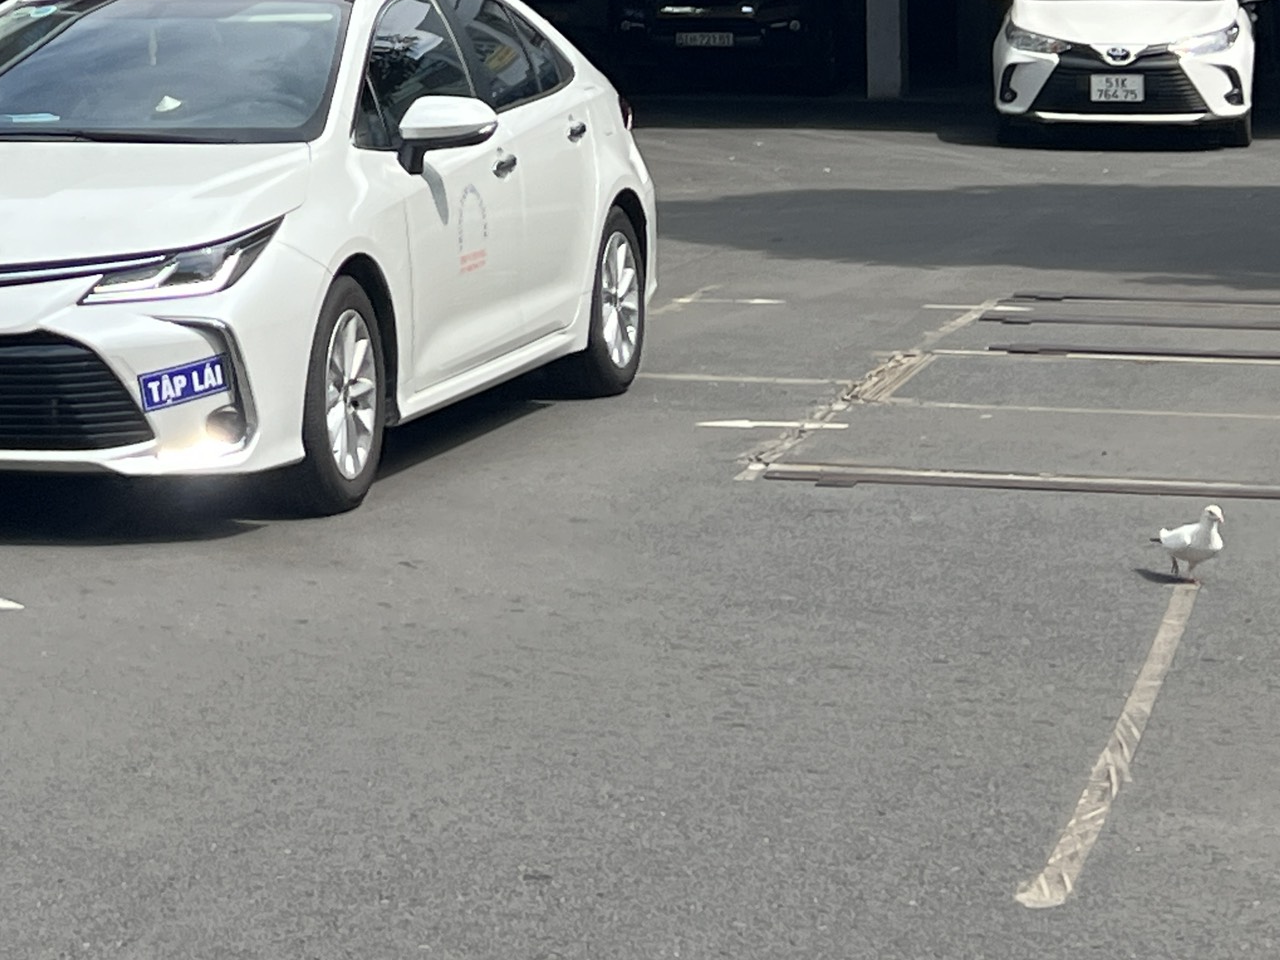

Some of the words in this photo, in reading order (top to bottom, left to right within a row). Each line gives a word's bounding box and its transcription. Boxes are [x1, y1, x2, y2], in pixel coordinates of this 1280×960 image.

[1105, 77, 1128, 88] 51K
[147, 374, 187, 405] TẬP
[191, 362, 223, 392] LÁI
